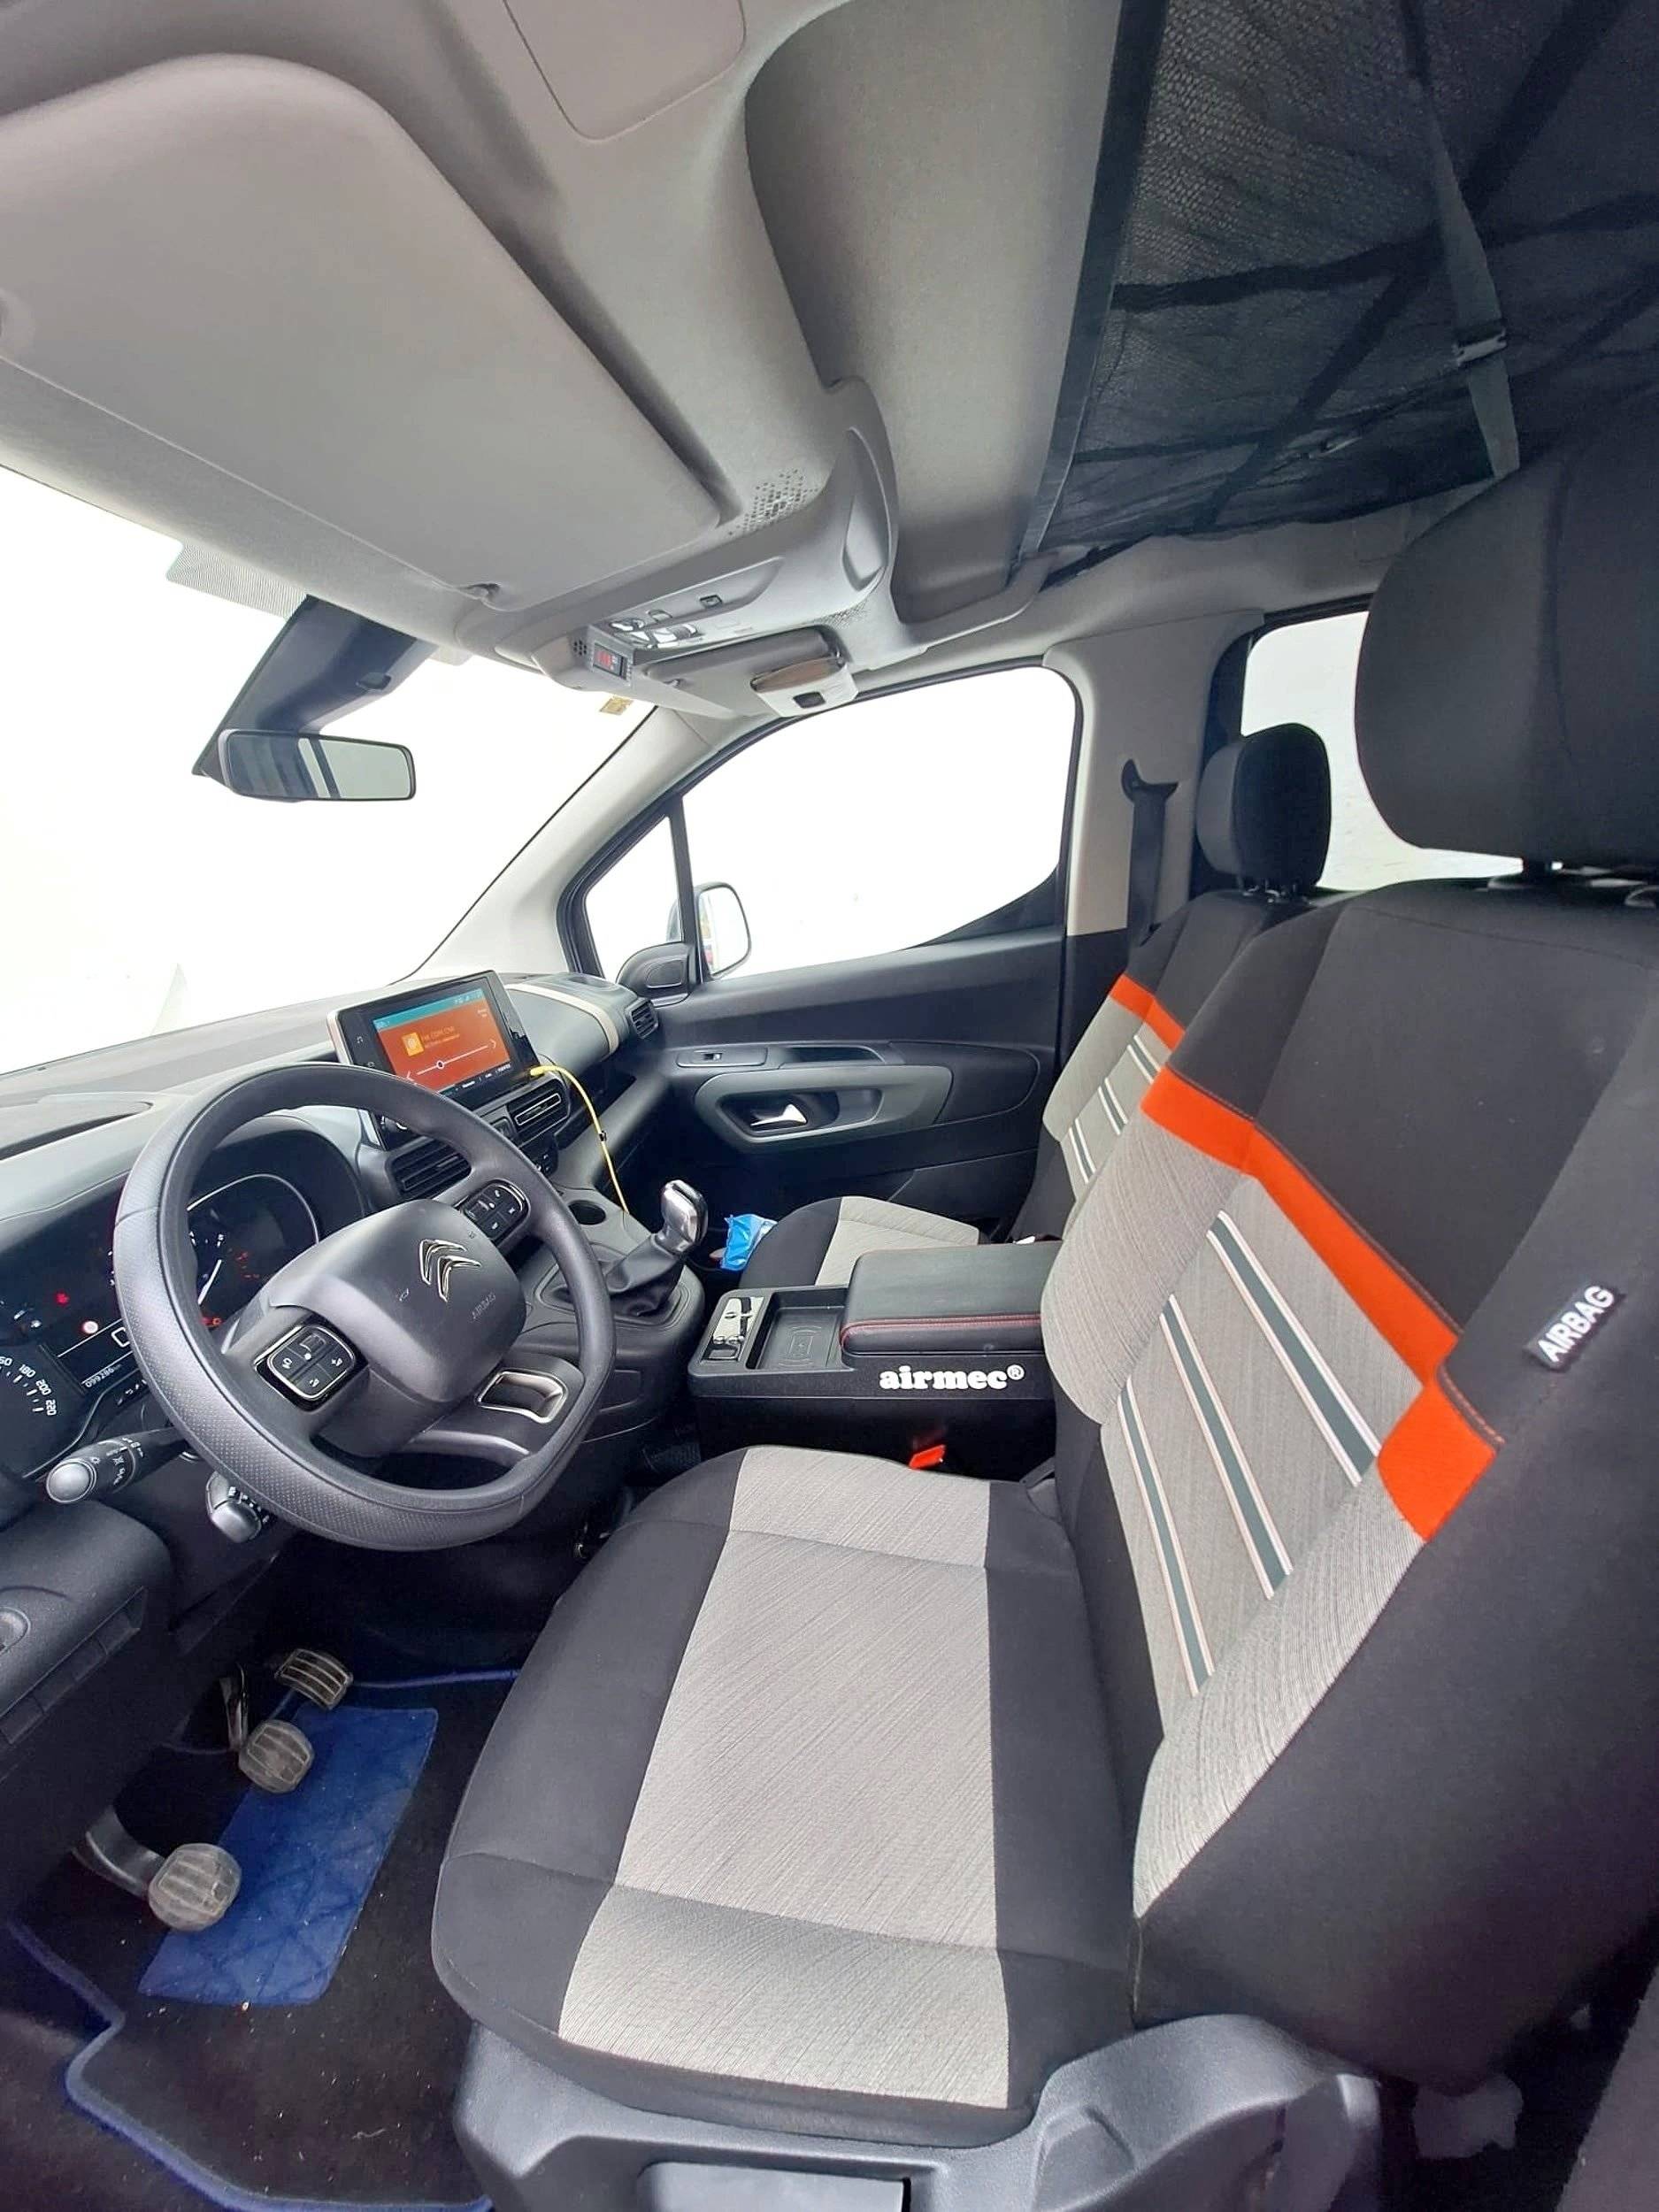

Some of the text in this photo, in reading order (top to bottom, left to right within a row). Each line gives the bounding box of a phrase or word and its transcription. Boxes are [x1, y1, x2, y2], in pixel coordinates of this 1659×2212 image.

[1538, 1286, 1615, 1363] AIRBAG
[19, 1363, 36, 1378] 180
[35, 1379, 52, 1395] 200
[45, 1399, 57, 1416] 220
